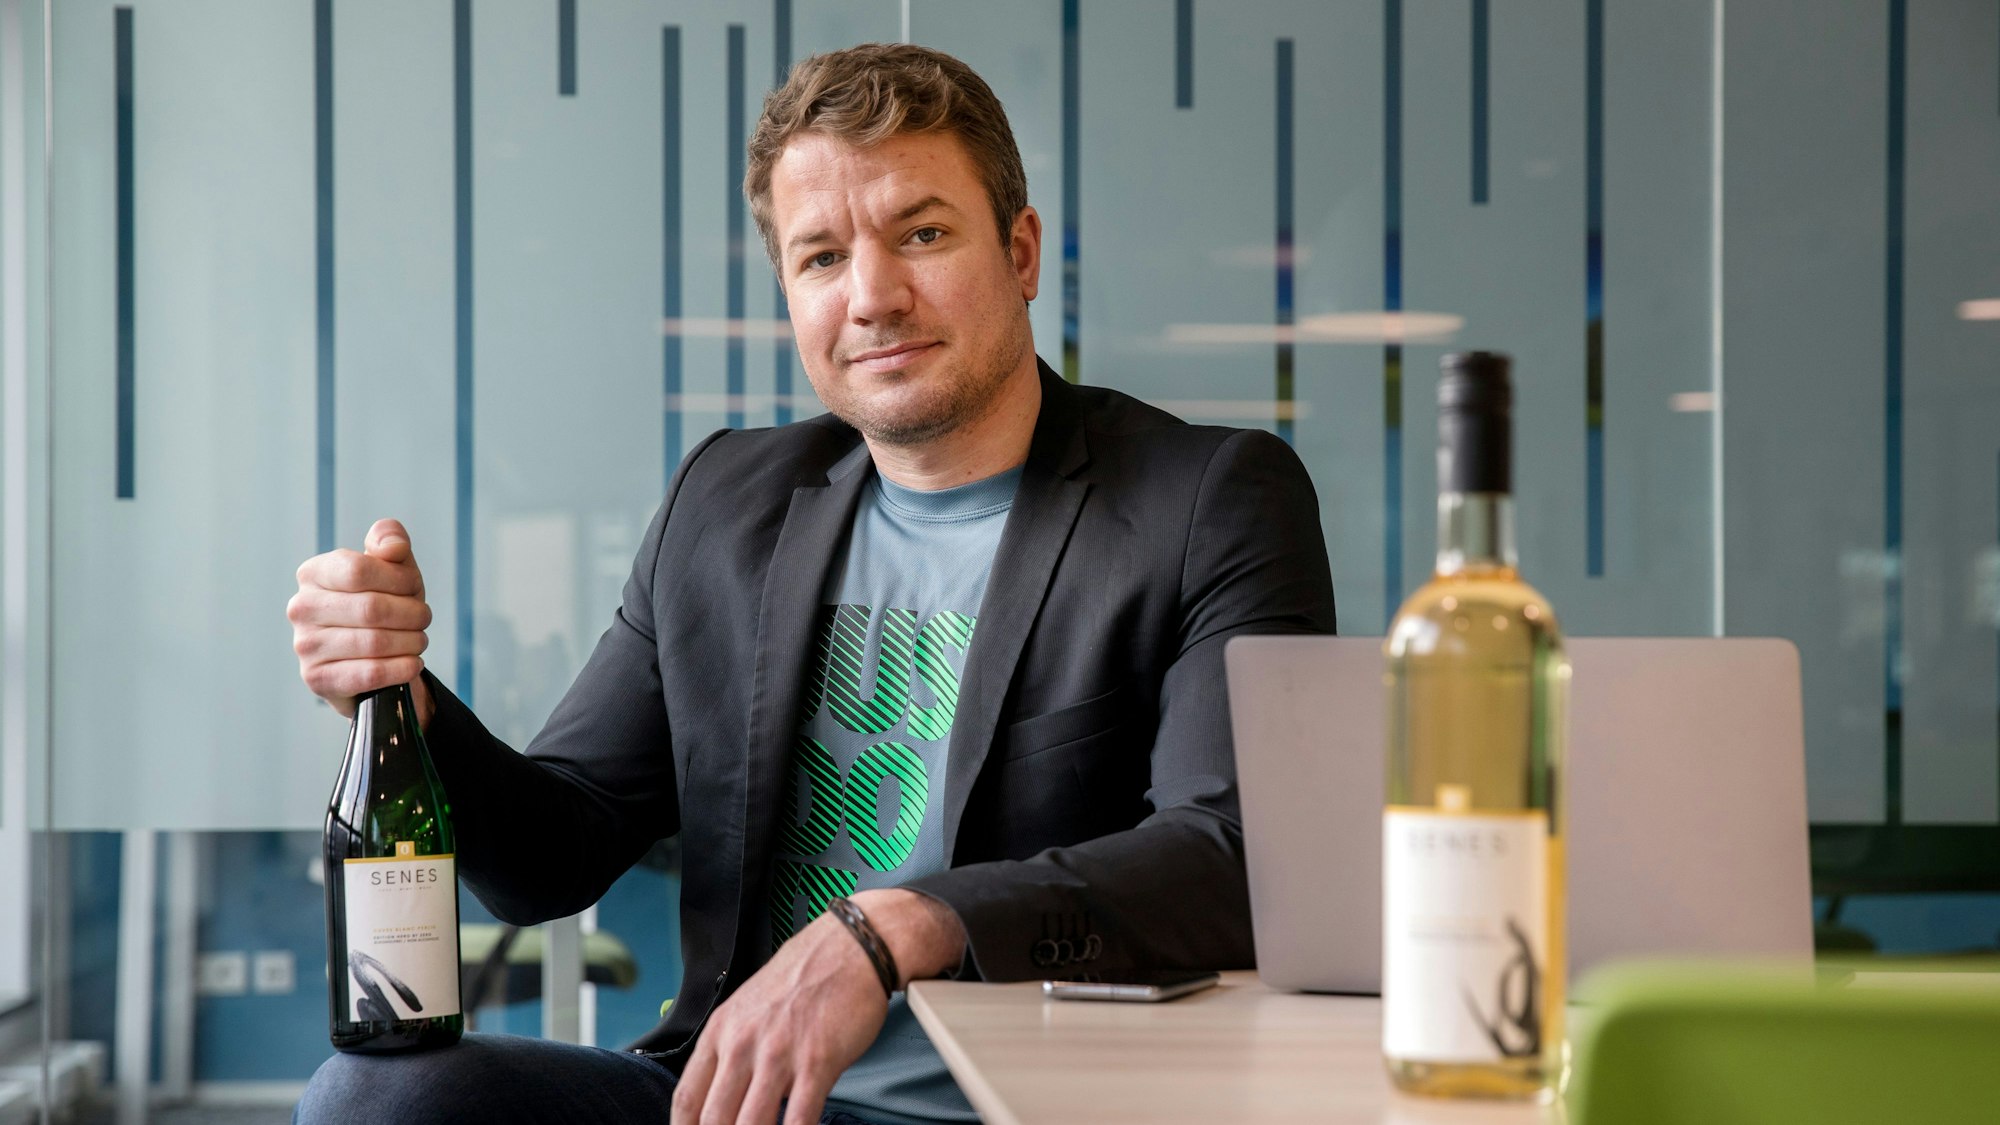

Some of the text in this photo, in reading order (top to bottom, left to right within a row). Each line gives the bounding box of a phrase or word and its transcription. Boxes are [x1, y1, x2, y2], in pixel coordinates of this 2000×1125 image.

[800, 604, 976, 741] US
[777, 735, 928, 872] DO
[371, 868, 437, 885] SENES
